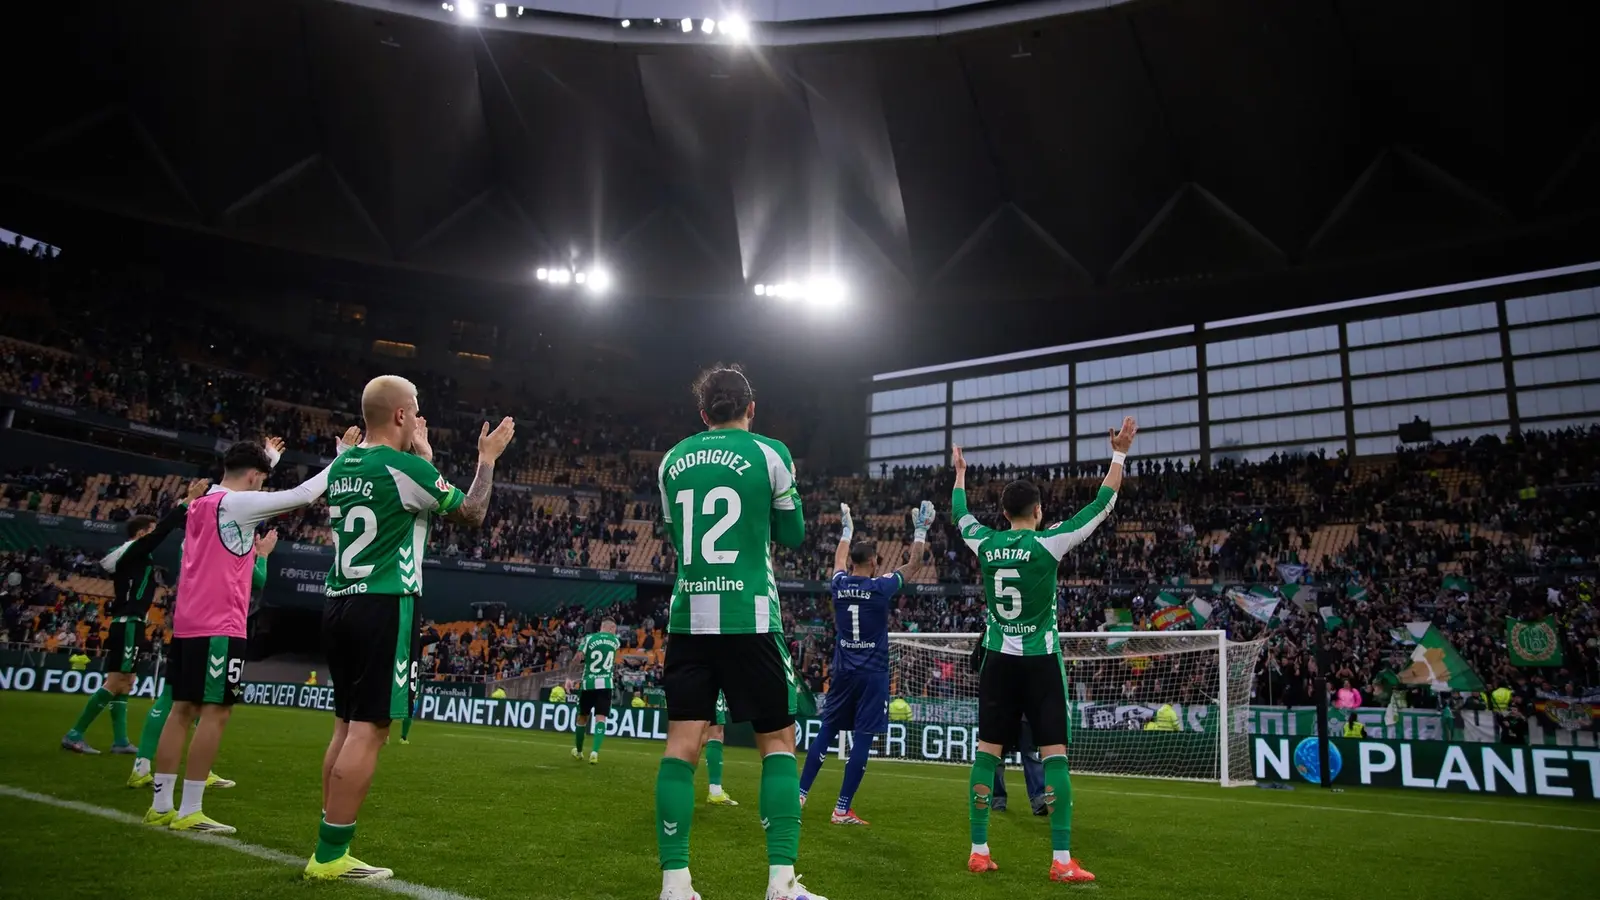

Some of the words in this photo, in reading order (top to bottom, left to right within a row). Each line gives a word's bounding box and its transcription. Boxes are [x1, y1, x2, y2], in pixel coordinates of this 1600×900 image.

[668, 450, 752, 480] RODRIGUEZ
[329, 477, 362, 499] PABLO
[675, 486, 742, 566] 12
[985, 548, 1031, 562] BARTRA
[684, 576, 745, 592] trainline
[994, 568, 1022, 620] 5
[847, 604, 860, 642] 1
[999, 623, 1037, 634] rainline
[846, 639, 876, 649] trainline
[227, 658, 245, 684] 5
[590, 650, 614, 673] 24
[0, 667, 36, 691] NO
[298, 686, 336, 711] GREE
[504, 699, 535, 729] NO
[540, 703, 668, 739] FOBALL
[1359, 742, 1600, 798] PLANET
